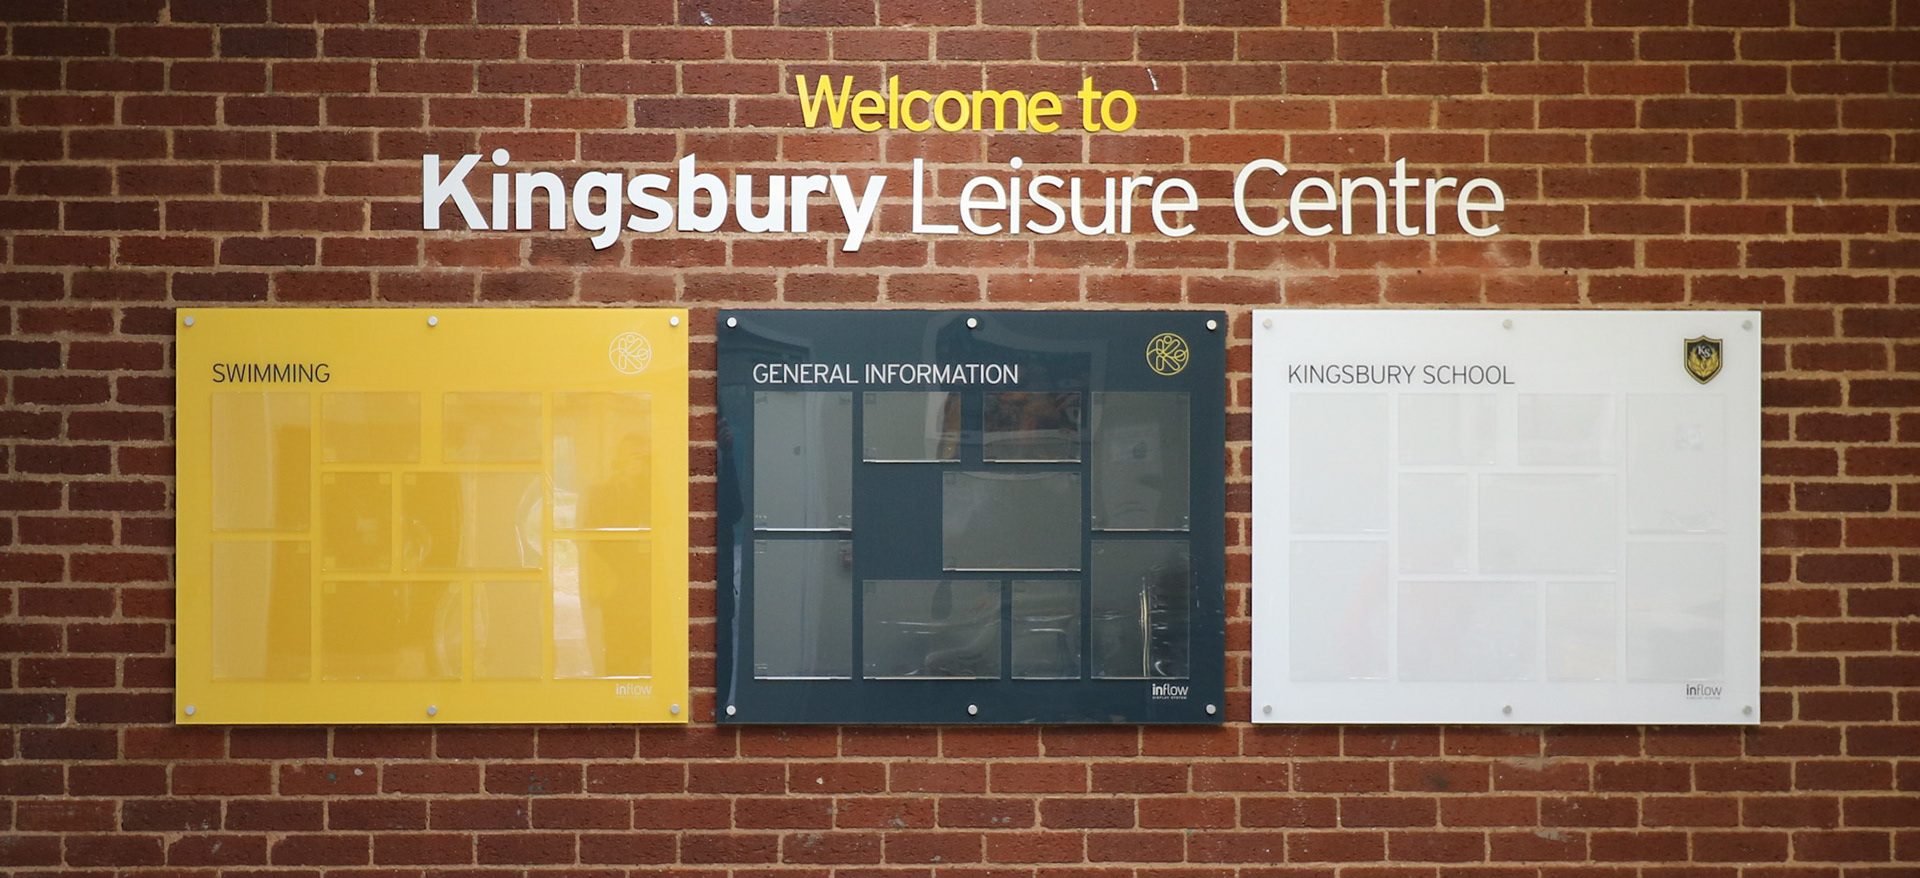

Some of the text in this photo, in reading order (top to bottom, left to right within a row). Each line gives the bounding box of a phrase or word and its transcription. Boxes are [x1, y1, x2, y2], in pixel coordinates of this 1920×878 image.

[796, 74, 1138, 133] Welcome to
[422, 148, 1505, 252] Kingsbury Leisure Centre
[212, 363, 330, 383] SWIMMING
[752, 363, 1019, 384] GENERAL INFORMATION
[1288, 364, 1515, 385] KINGSBURY SCHOOL
[615, 683, 652, 696] inflow
[1152, 683, 1189, 696] inflow
[1686, 684, 1723, 696] inflow
